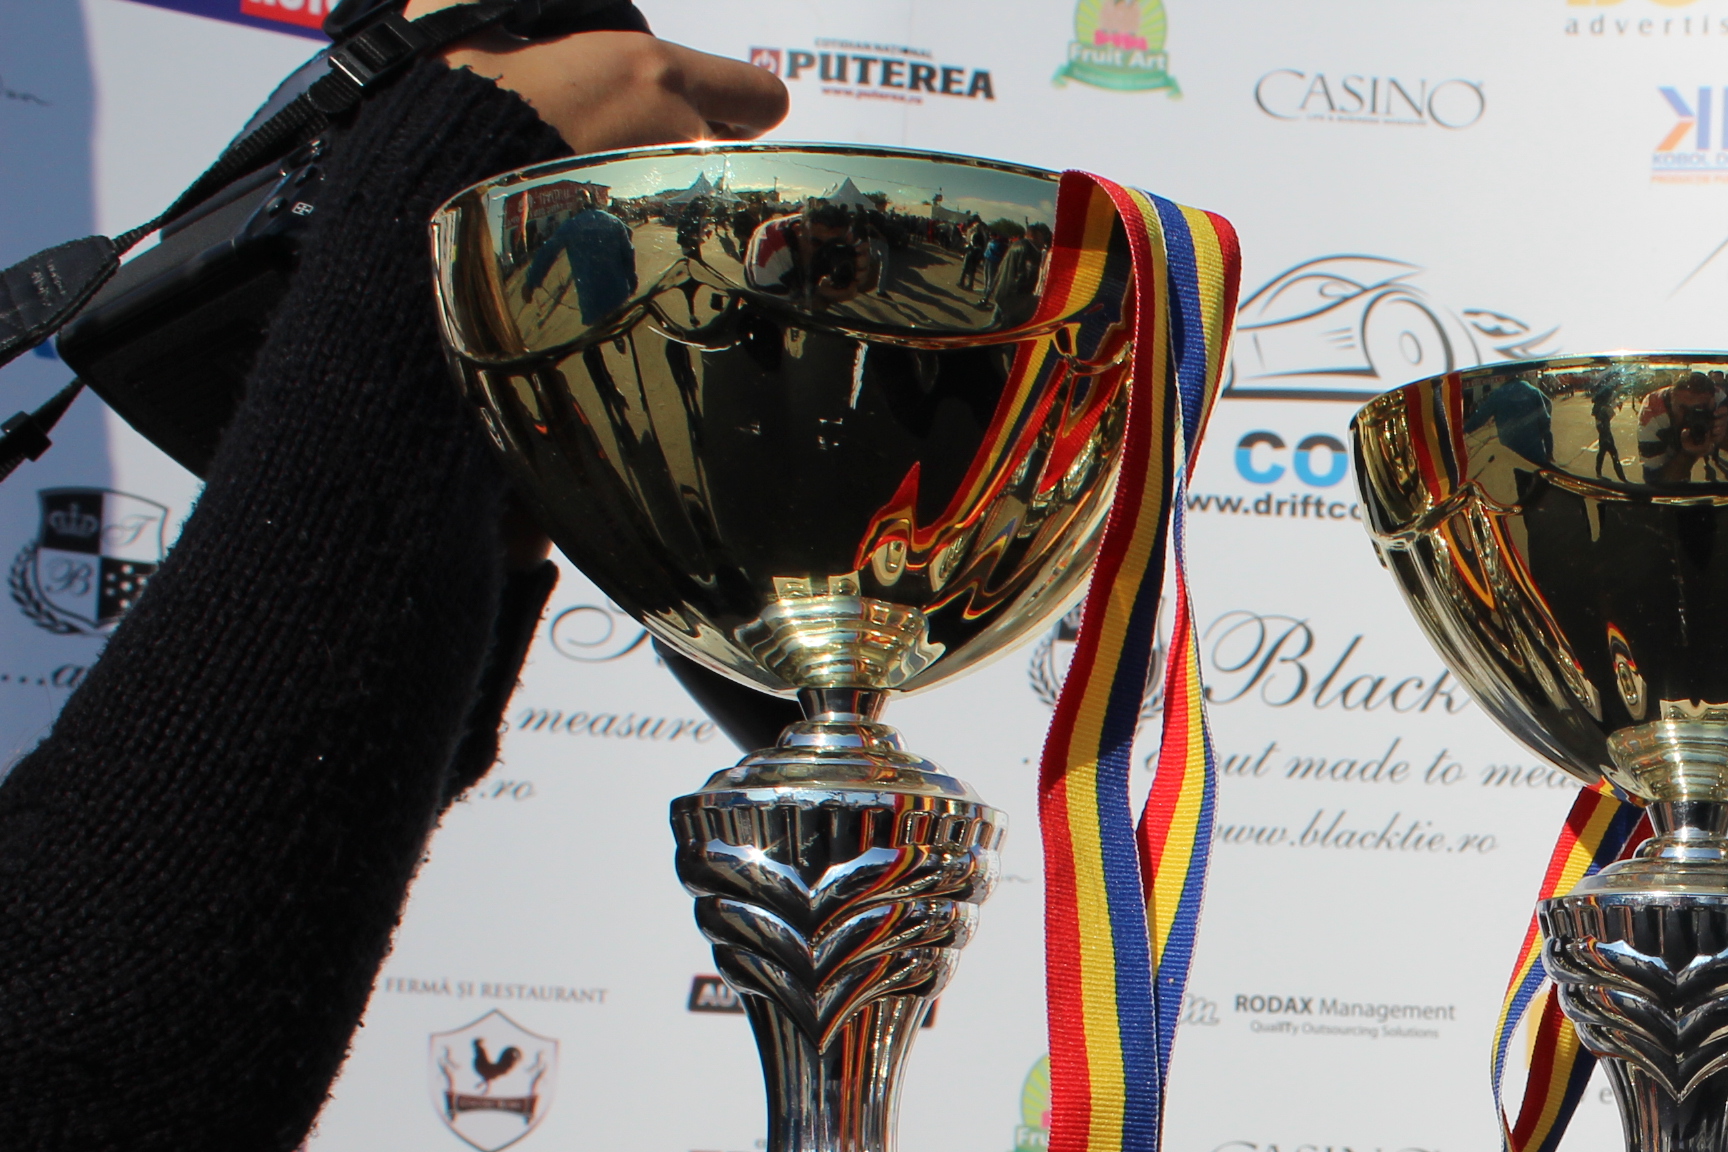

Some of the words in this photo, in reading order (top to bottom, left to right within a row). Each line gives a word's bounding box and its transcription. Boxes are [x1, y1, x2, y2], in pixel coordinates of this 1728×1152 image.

[786, 49, 996, 101] PUTEREA
[1128, 50, 1169, 71] Art
[1253, 68, 1486, 130] CASINO
[515, 706, 718, 744] measure
[1286, 736, 1411, 782] made
[1424, 748, 1466, 785] to
[1216, 807, 1498, 855] ww.blacktie.ro
[480, 981, 609, 1004] RESTAURANT
[1235, 994, 1313, 1016] RODAX
[1319, 998, 1457, 1023] Management
